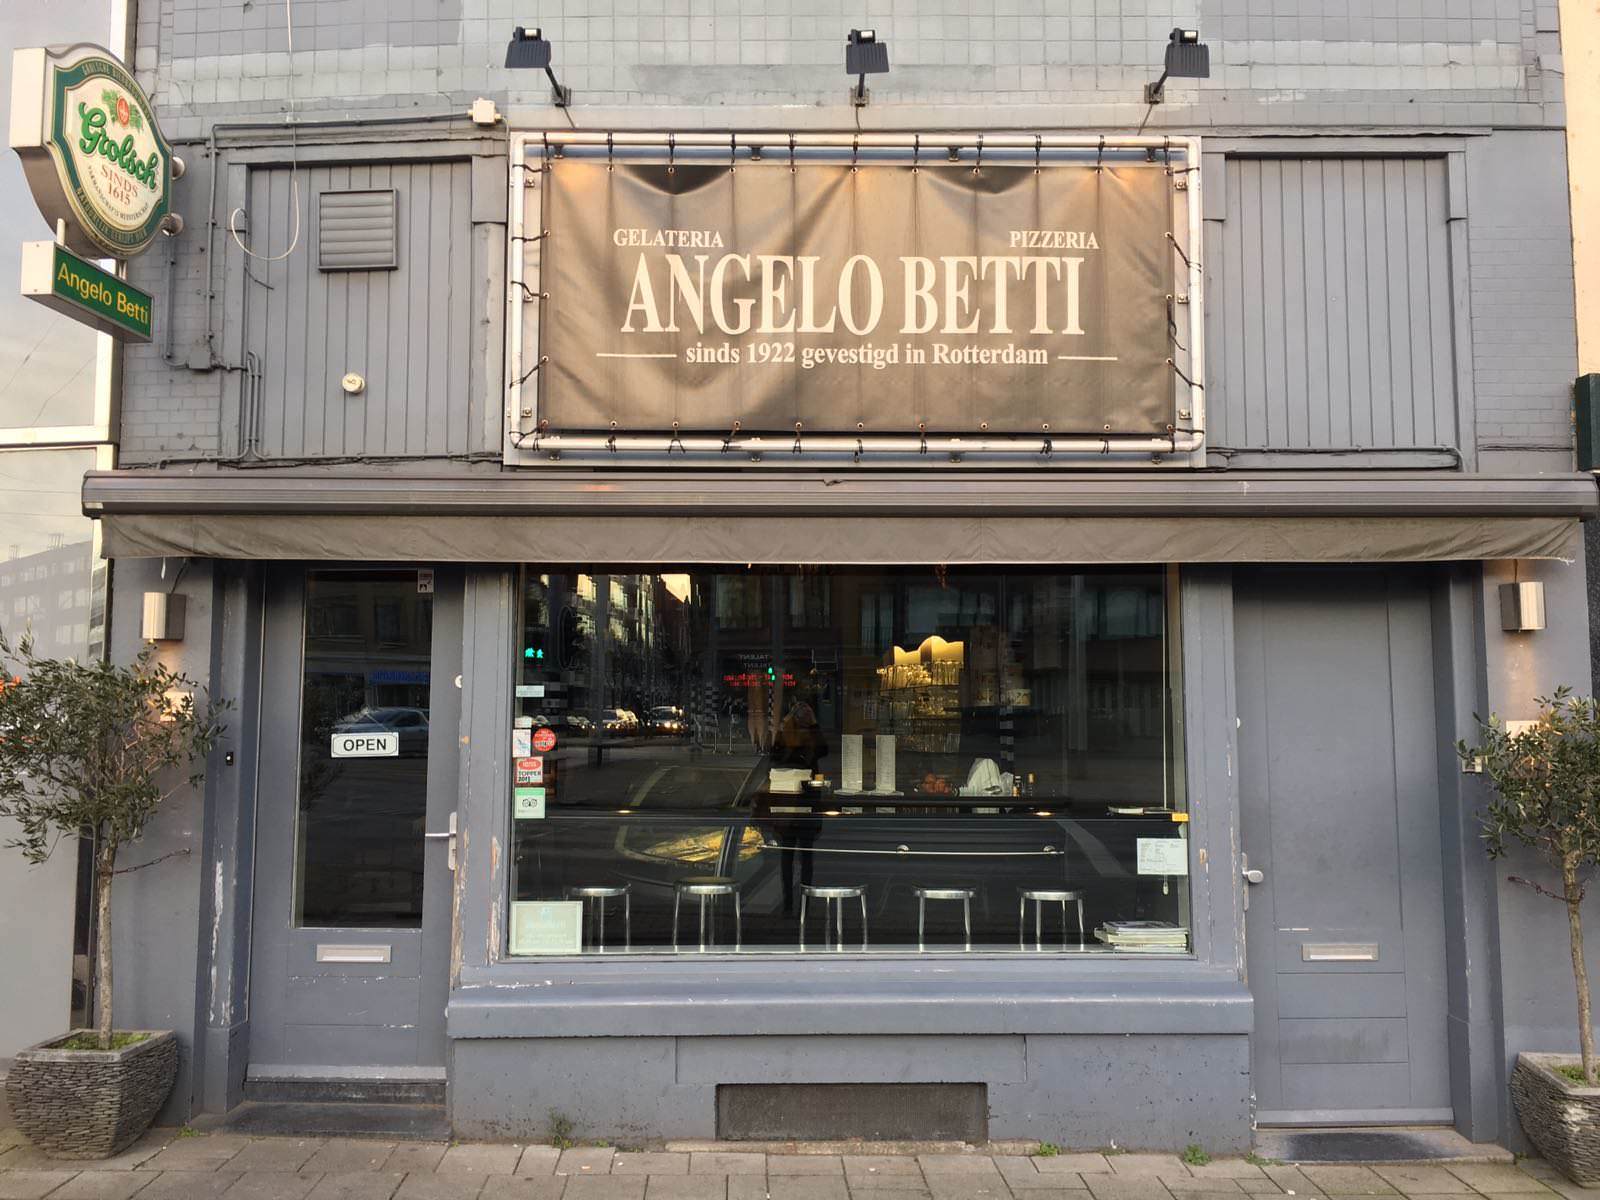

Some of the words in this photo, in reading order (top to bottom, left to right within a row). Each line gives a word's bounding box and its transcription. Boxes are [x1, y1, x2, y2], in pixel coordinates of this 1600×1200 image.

[79, 102, 158, 190] Grolsch
[100, 164, 139, 198] SINDS
[107, 182, 131, 206] 1615
[613, 228, 724, 248] GELATERIA
[1009, 230, 1100, 250] PIZZERIA
[57, 262, 112, 307] Angelo
[116, 290, 150, 325] Betti
[620, 252, 884, 336] ANGELO
[899, 256, 1085, 335] BETTI
[686, 342, 740, 363] sinds
[747, 342, 795, 363] 1922
[801, 343, 899, 369] gevestigd
[906, 343, 925, 364] in
[931, 344, 1049, 365] Rotterdam
[343, 738, 387, 752] OPEN
